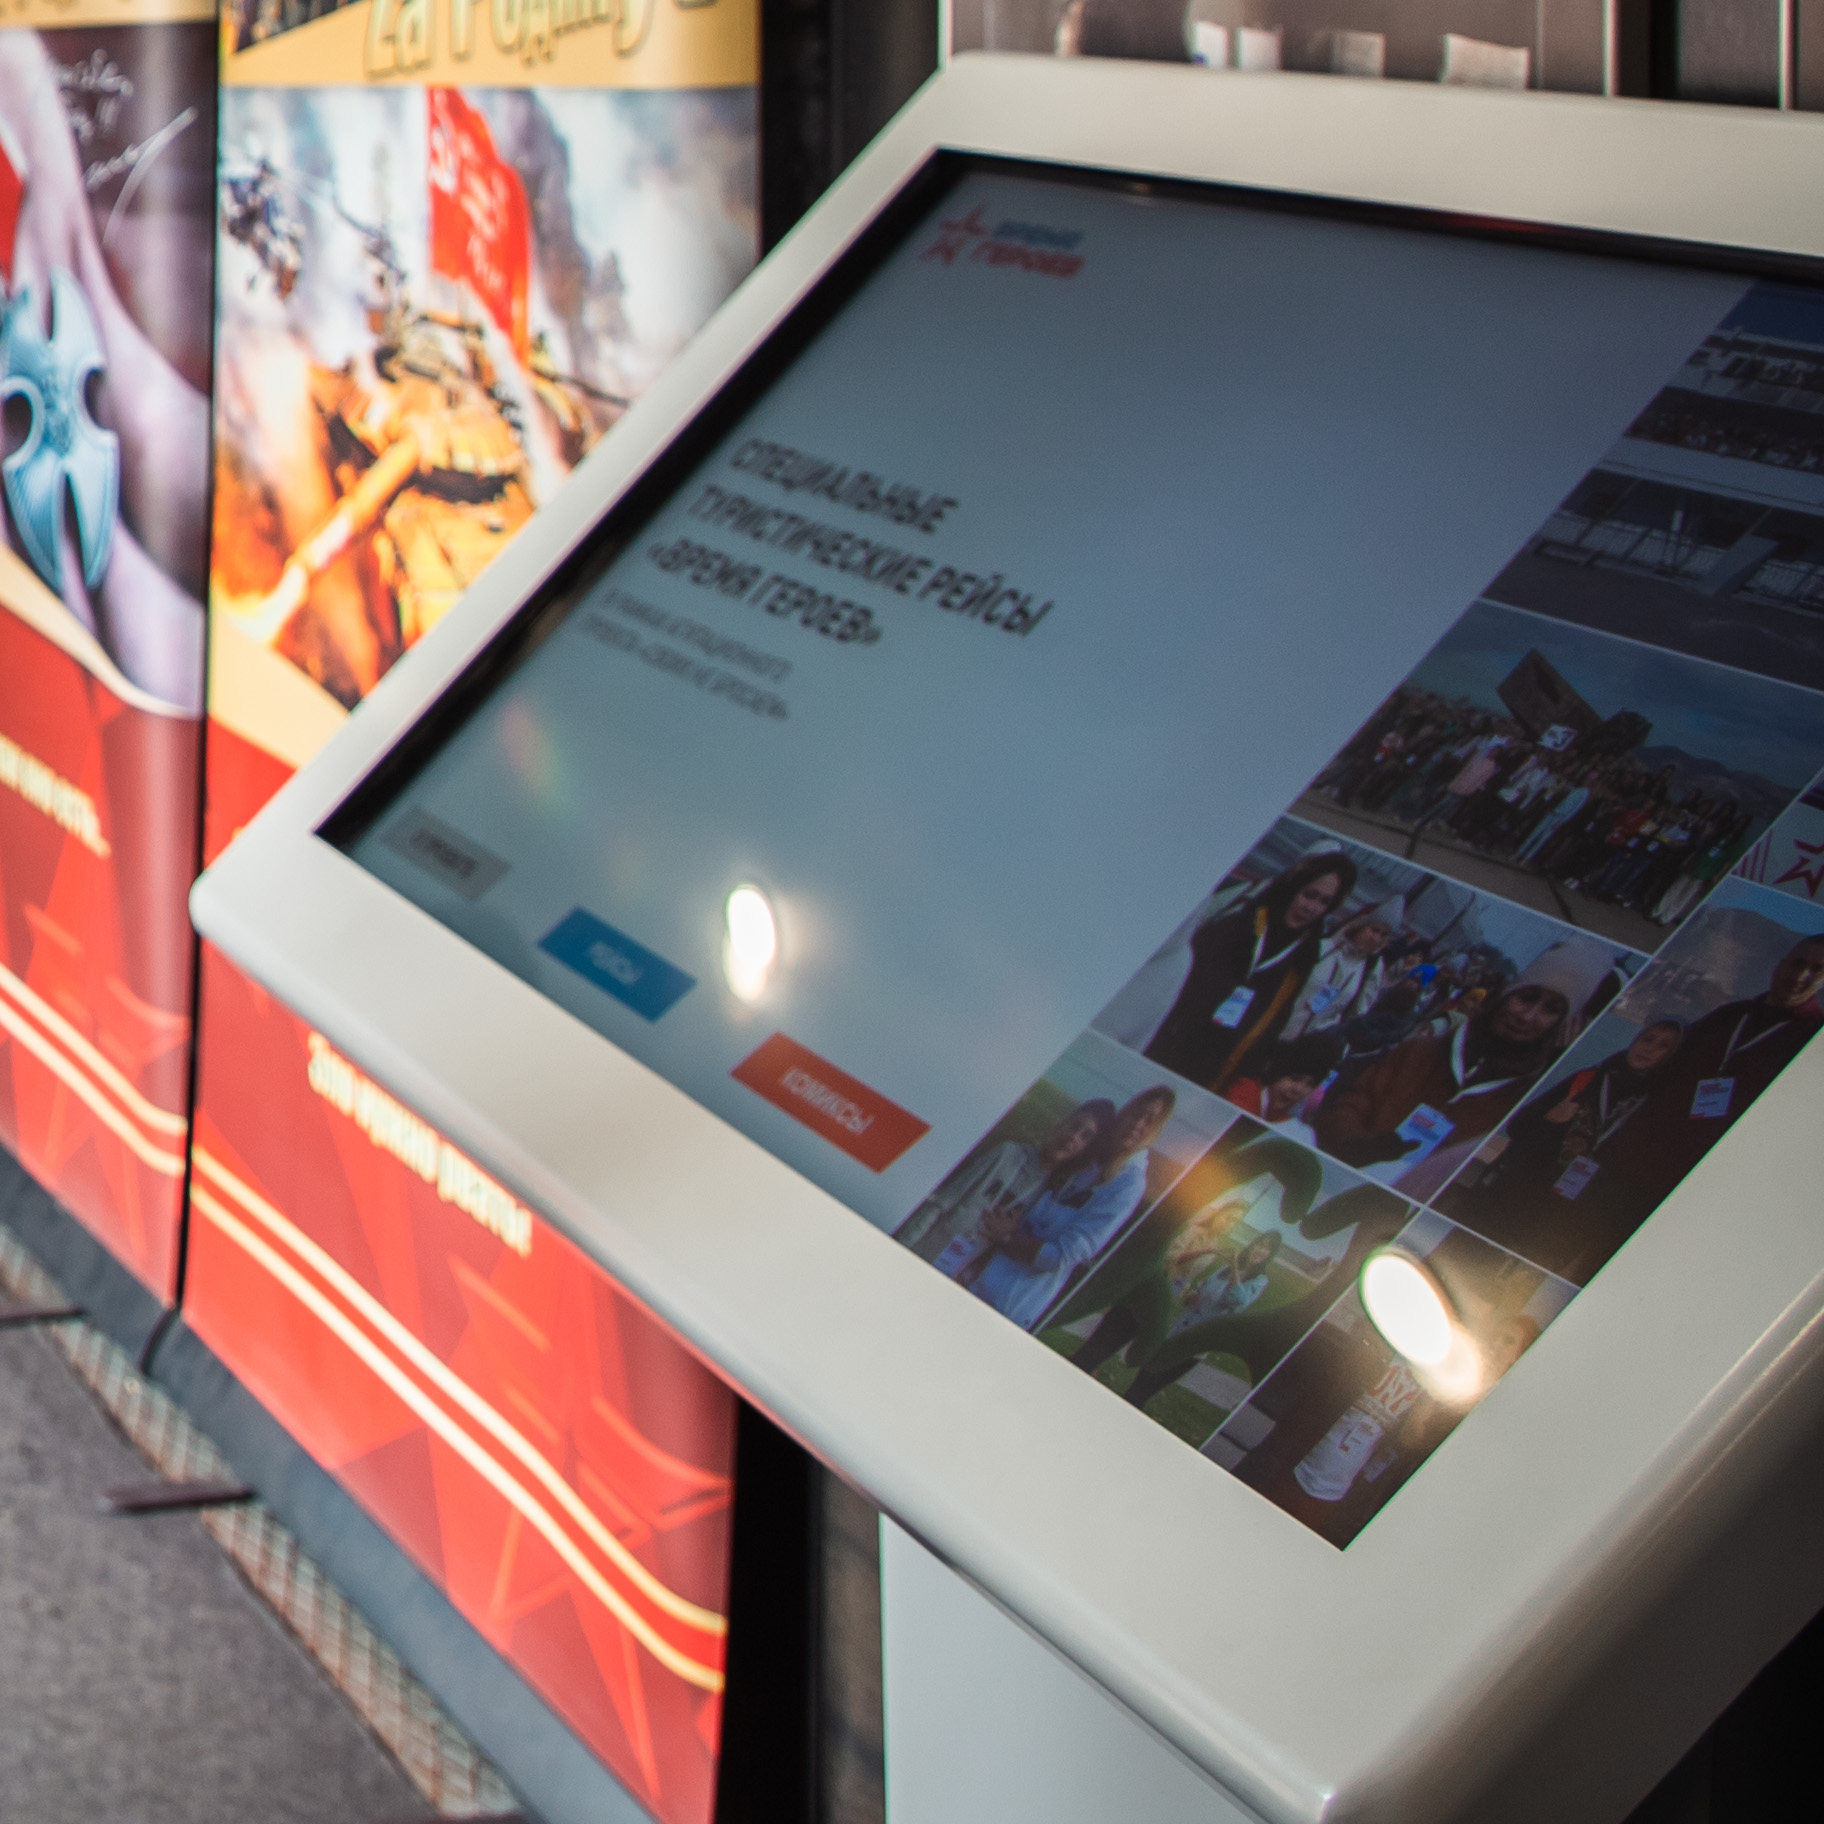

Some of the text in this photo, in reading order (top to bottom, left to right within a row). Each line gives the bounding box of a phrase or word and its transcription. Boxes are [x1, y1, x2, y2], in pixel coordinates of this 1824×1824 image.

[729, 437, 960, 536] СПЕЦИАЛЬНЫЕ
[688, 483, 1056, 640] ТУРИСТИЧЕСКИЕ РЕЙСЫ
